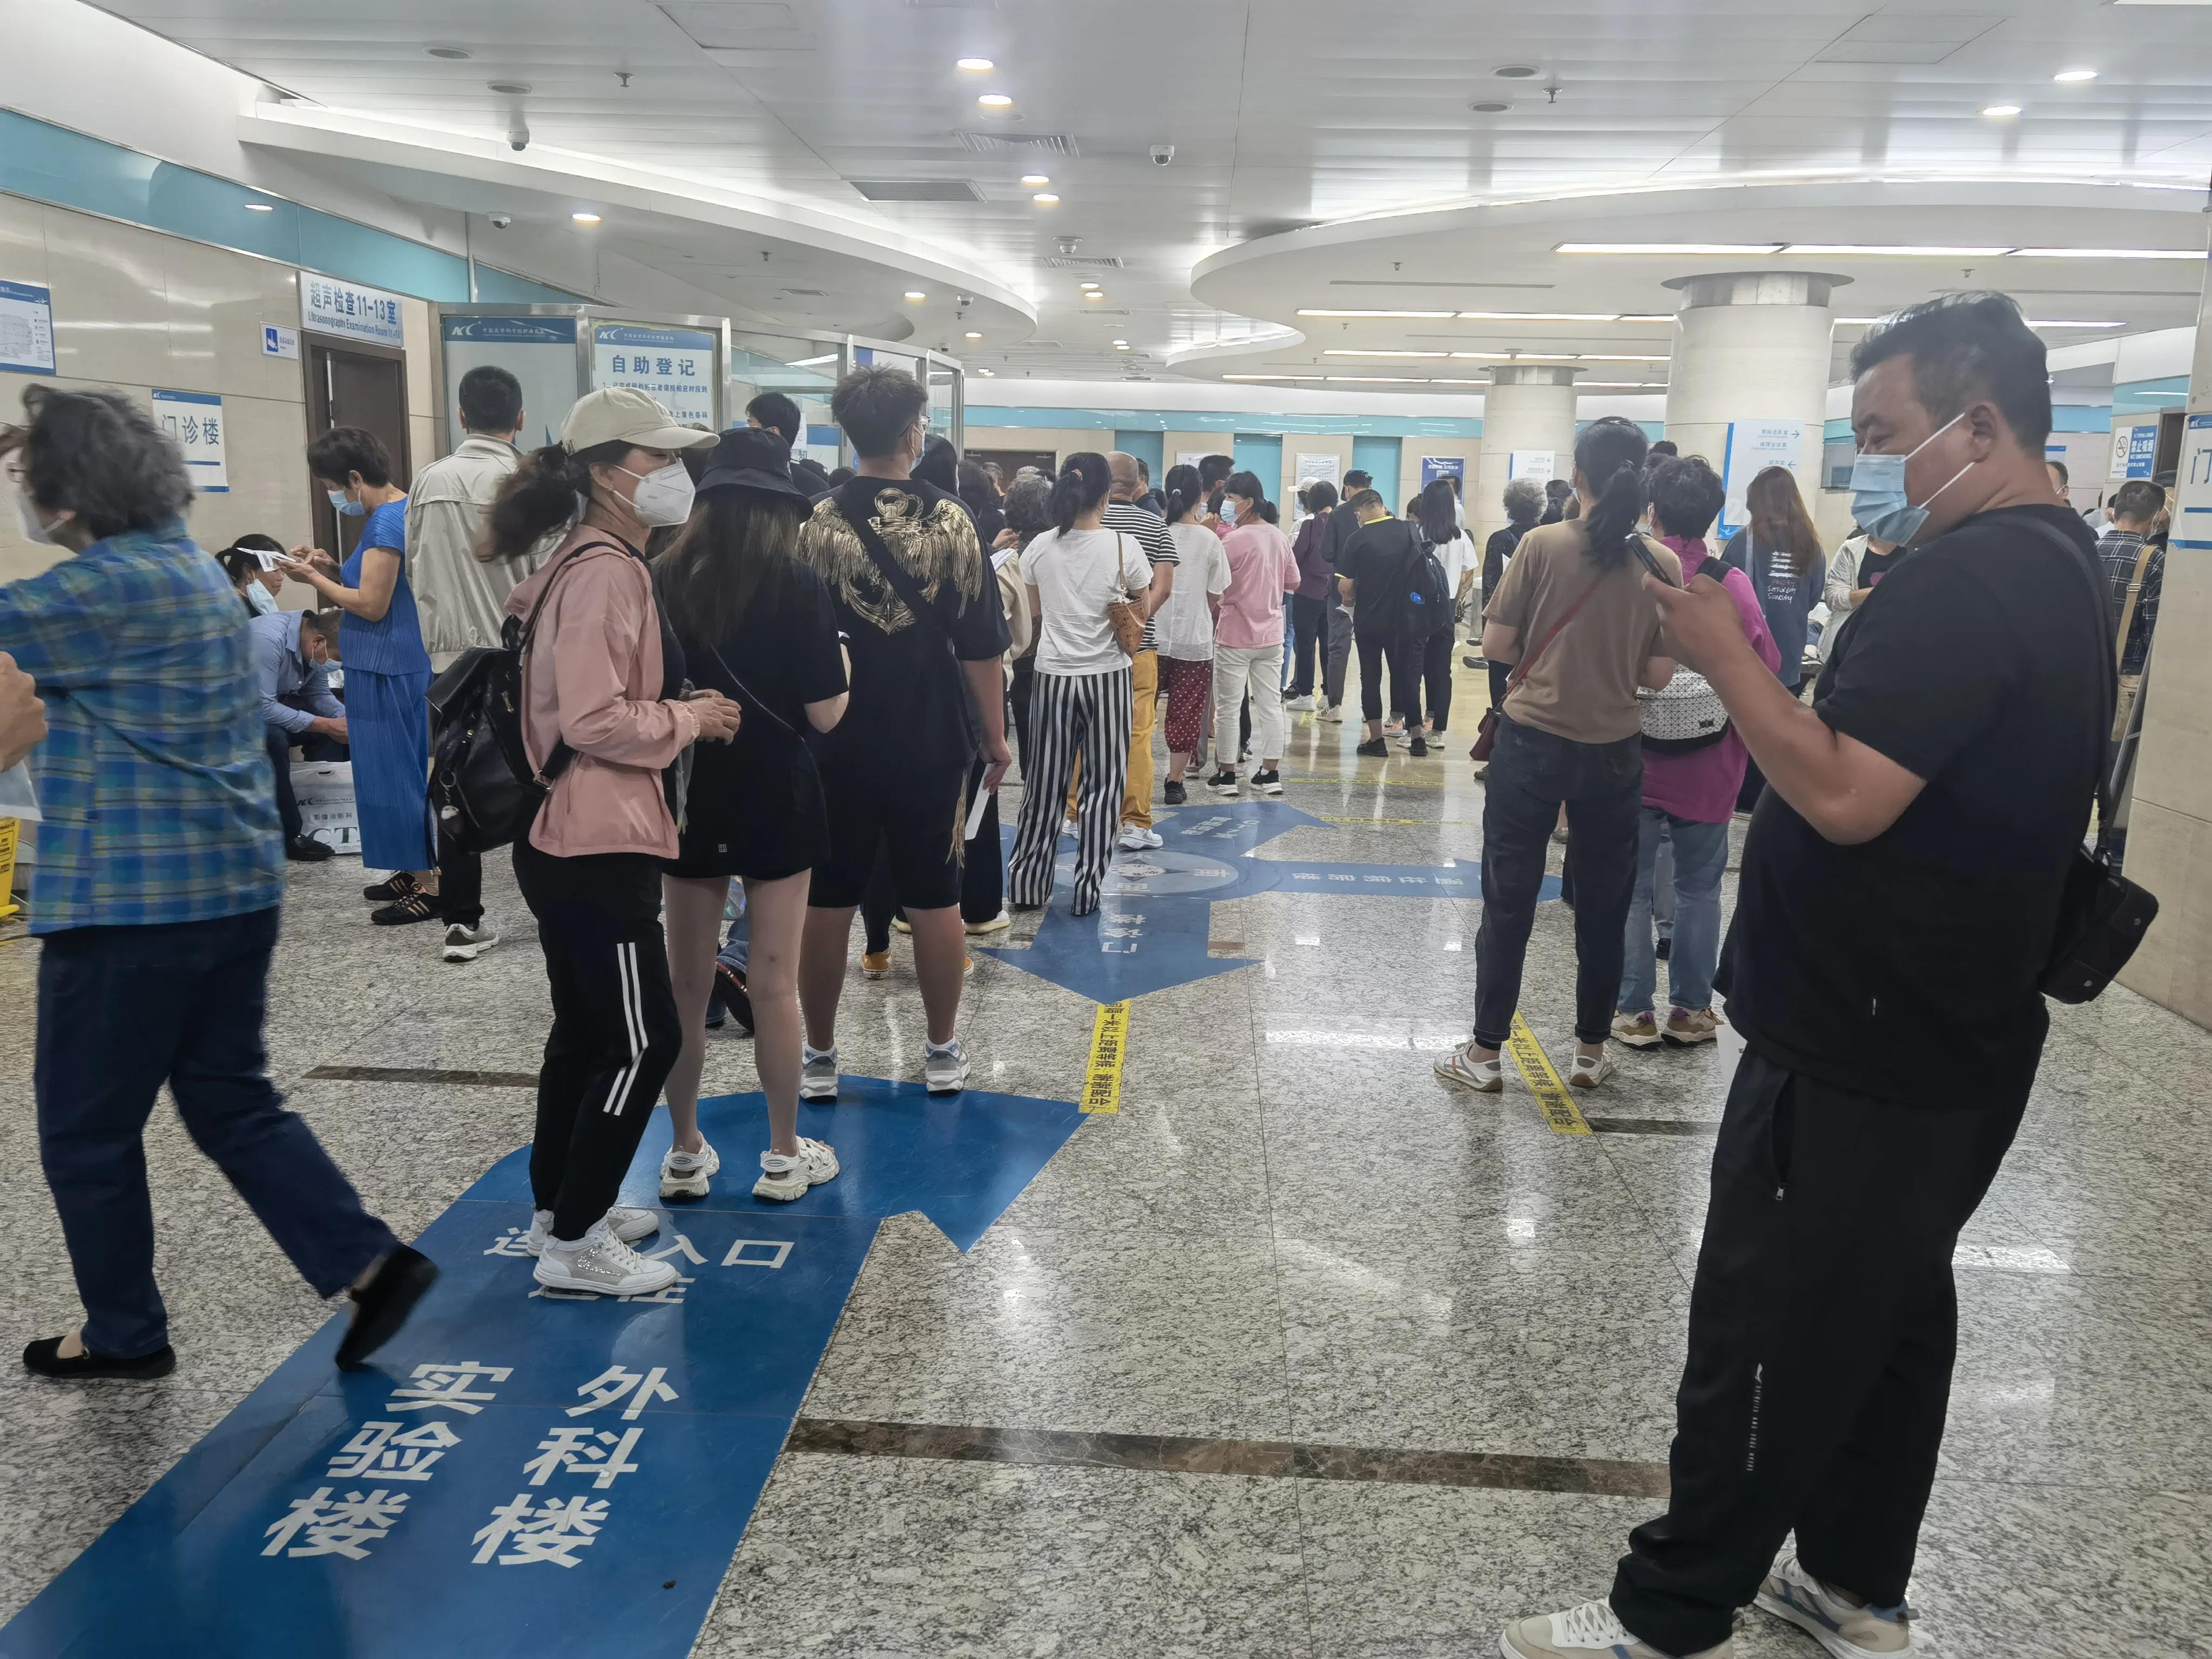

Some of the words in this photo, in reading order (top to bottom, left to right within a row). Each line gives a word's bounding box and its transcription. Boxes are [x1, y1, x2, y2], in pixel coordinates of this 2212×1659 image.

[311, 280, 397, 325] 超声检查11-13室
[346, 319, 374, 334] Examination
[612, 354, 695, 376] 自助登记
[162, 414, 219, 445] 门诊楼
[2130, 440, 2154, 453] 禁止吸烟
[1768, 592, 1793, 603] SUNDAY
[1101, 914, 1147, 954] 门诊楼
[260, 1360, 514, 1560] 实验楼
[471, 1365, 679, 1568] 外科楼
